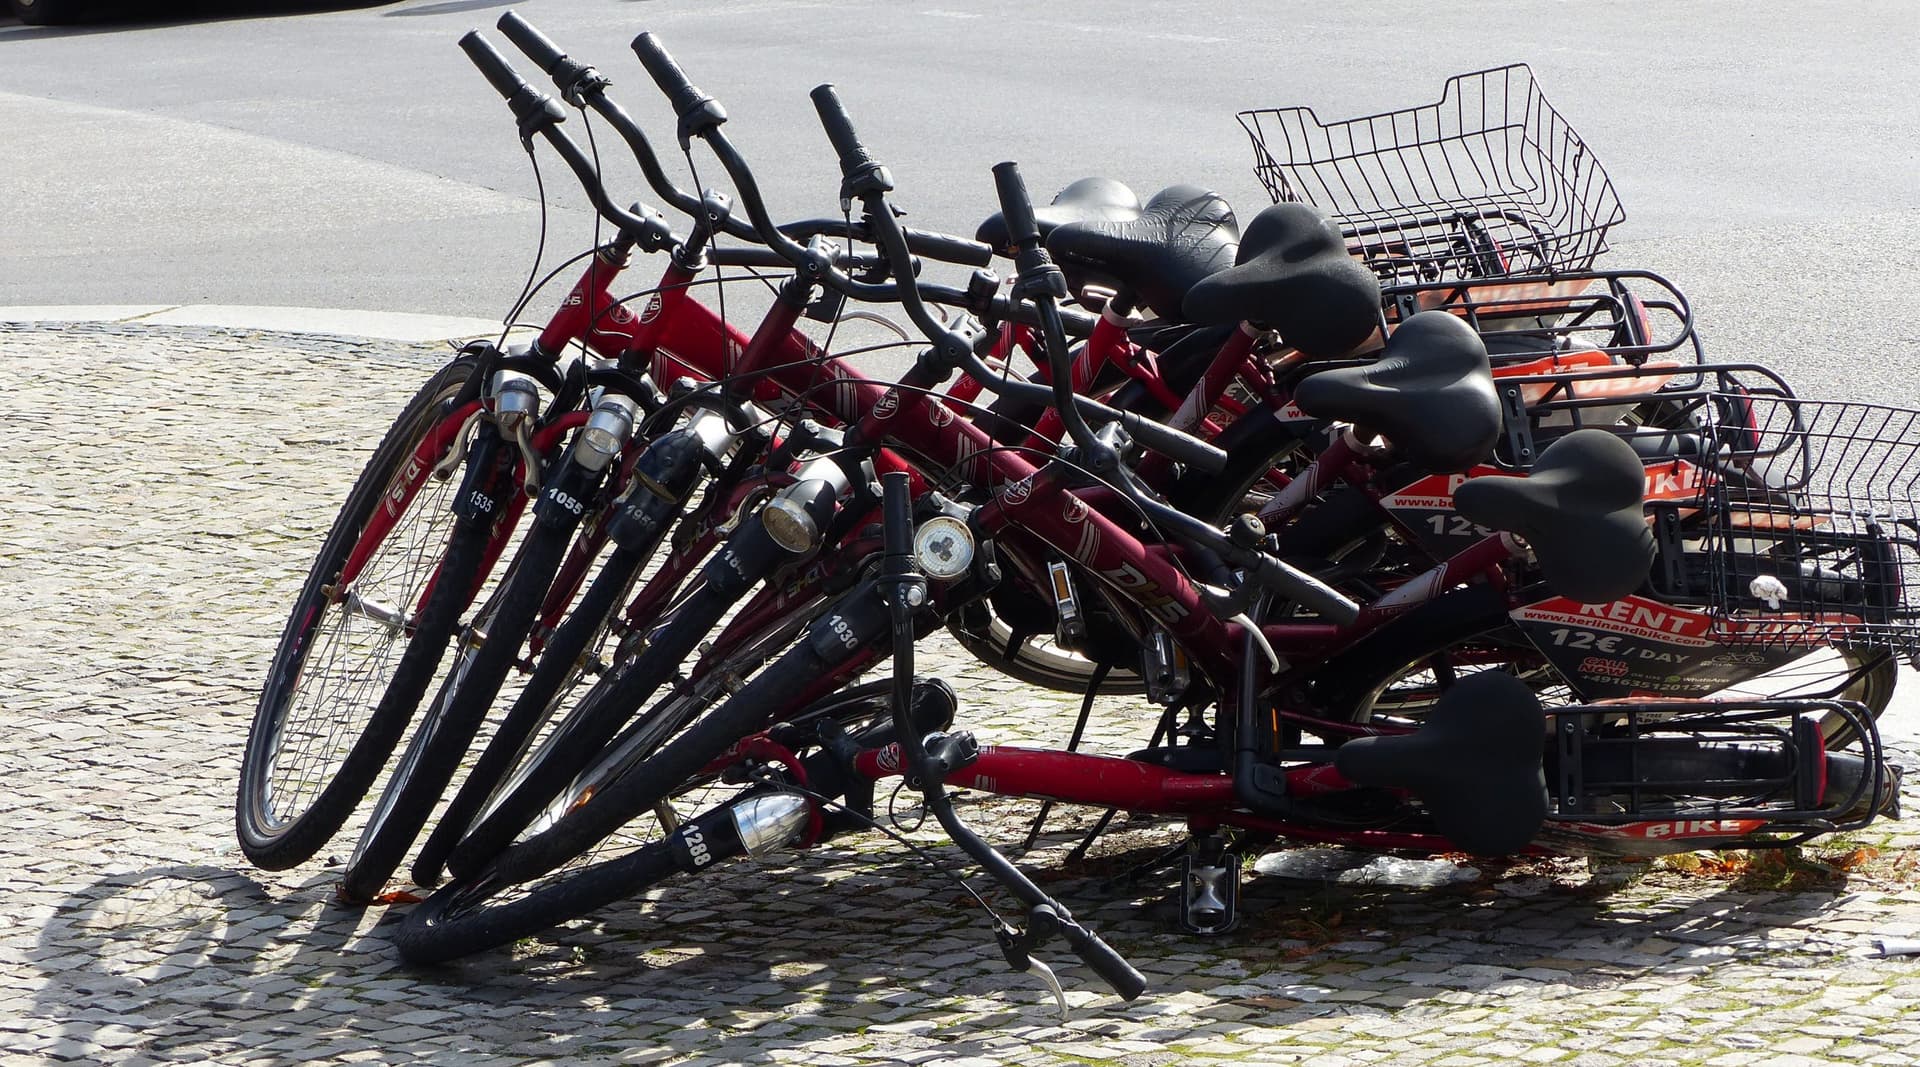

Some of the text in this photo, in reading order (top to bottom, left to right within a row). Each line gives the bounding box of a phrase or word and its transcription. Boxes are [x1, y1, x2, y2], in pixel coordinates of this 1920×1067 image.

[391, 460, 421, 503] DHS
[470, 490, 494, 512] 1535
[549, 487, 584, 515] 1055
[1102, 561, 1190, 624] DHS
[829, 615, 859, 649] 1930
[1524, 611, 1706, 646] www.berlinandbike.com
[1579, 600, 1694, 633] RENT
[1550, 628, 1622, 653] 12€
[1640, 649, 1690, 663] DAY
[1579, 664, 1627, 677] NOW
[1584, 657, 1626, 669] CALL
[682, 824, 712, 866] 1288
[1644, 819, 1740, 838] BIKE
